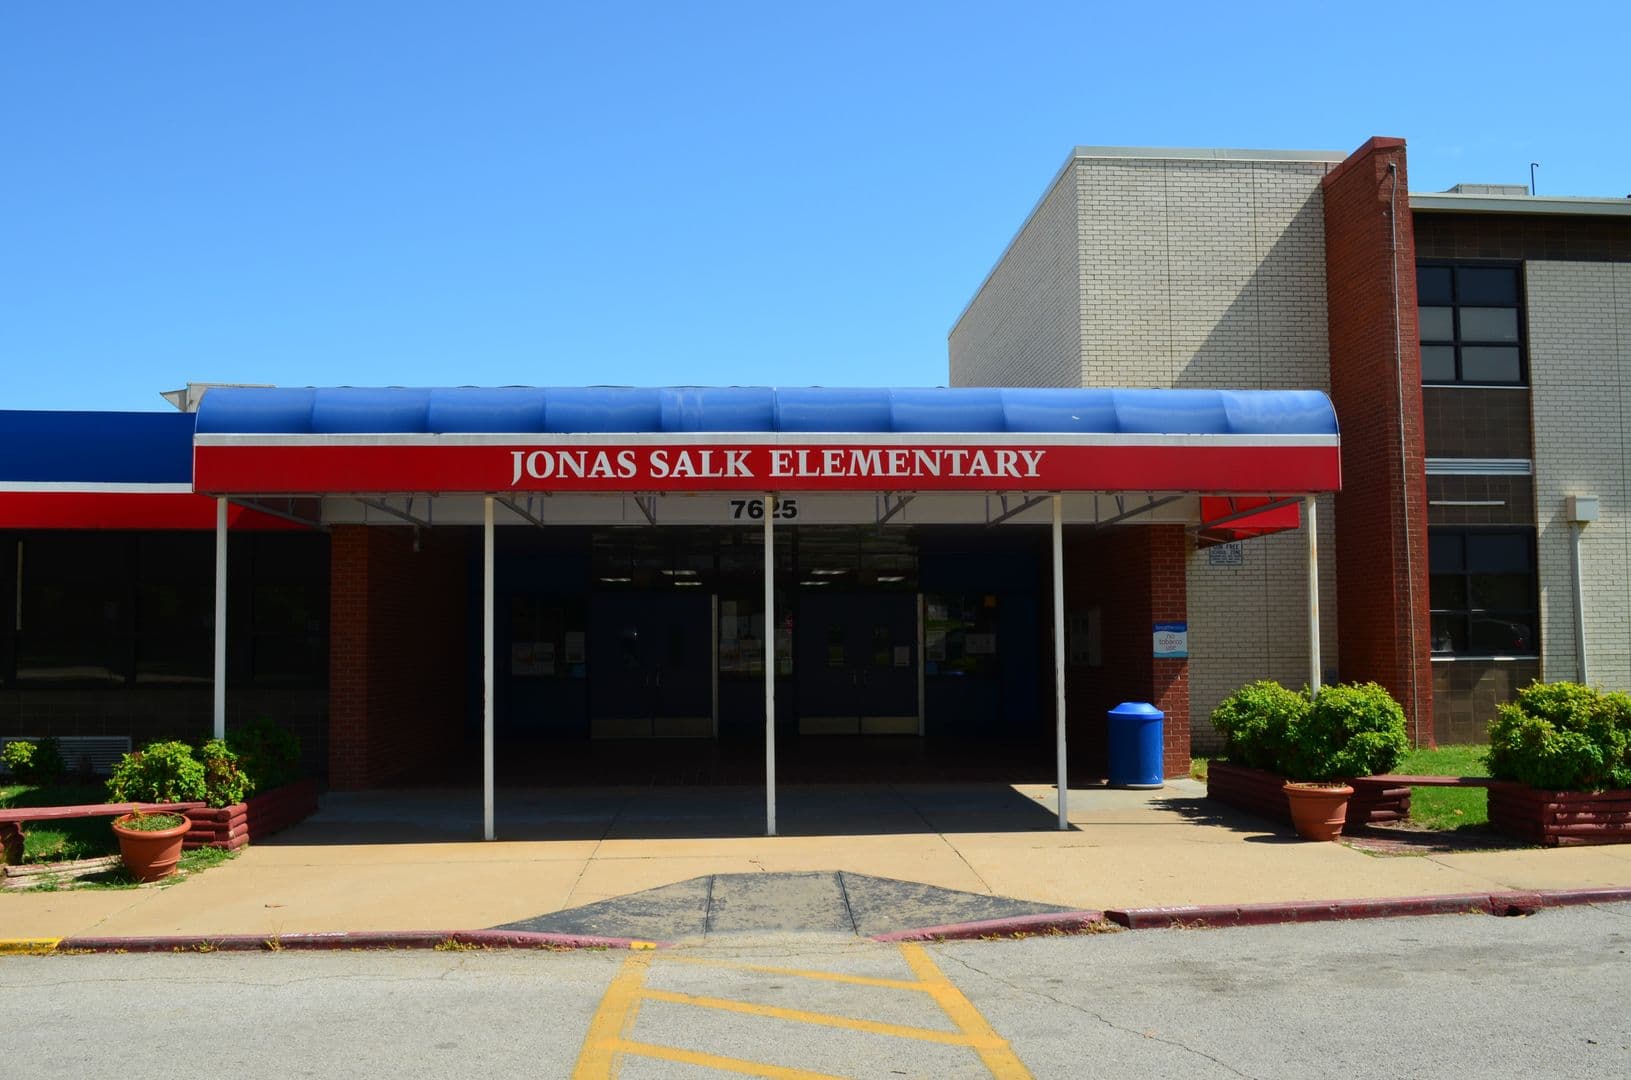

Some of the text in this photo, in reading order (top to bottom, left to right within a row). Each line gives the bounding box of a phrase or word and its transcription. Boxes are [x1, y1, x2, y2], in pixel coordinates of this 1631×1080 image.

[510, 449, 1046, 486] JONAS SALK ELEMENTARY
